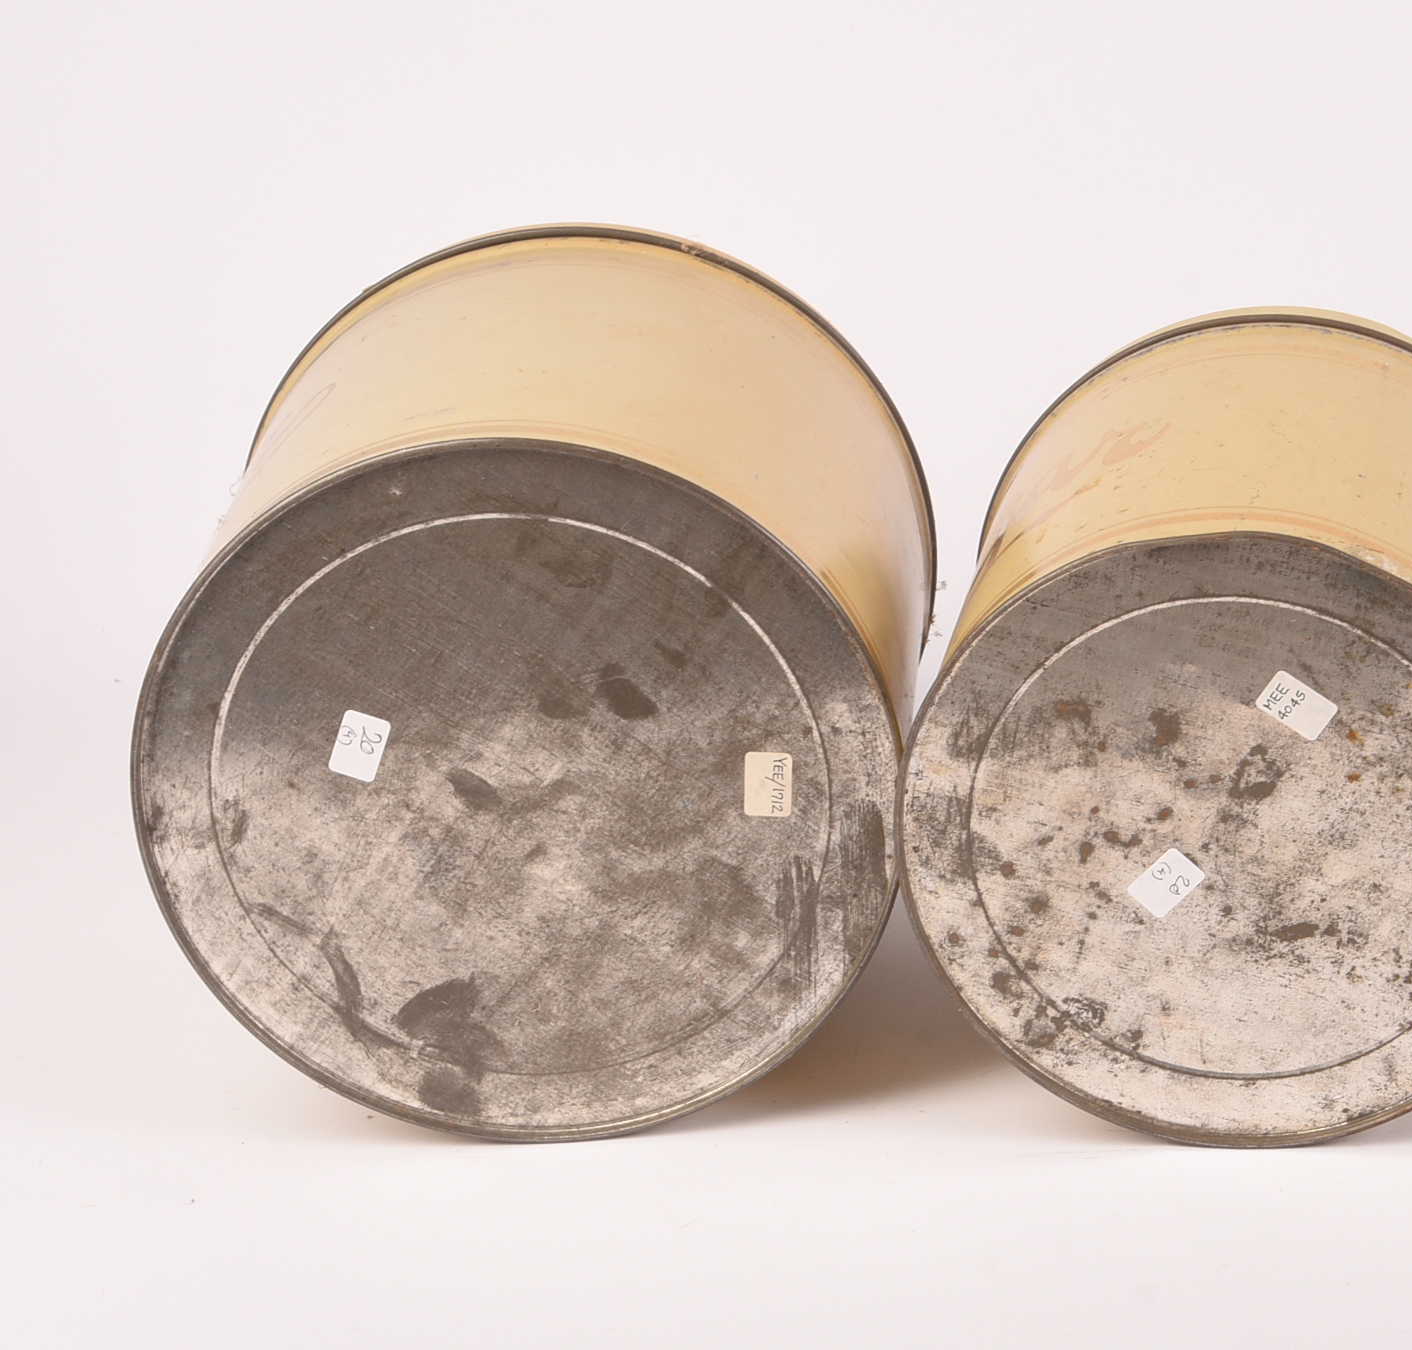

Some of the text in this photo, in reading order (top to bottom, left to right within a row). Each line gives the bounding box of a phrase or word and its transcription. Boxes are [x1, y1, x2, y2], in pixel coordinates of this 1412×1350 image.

[1262, 682, 1290, 711] MEE
[1278, 689, 1306, 720] 4045
[360, 725, 382, 755] 20
[764, 757, 788, 814] YEE/1712
[1168, 874, 1190, 896] 20
